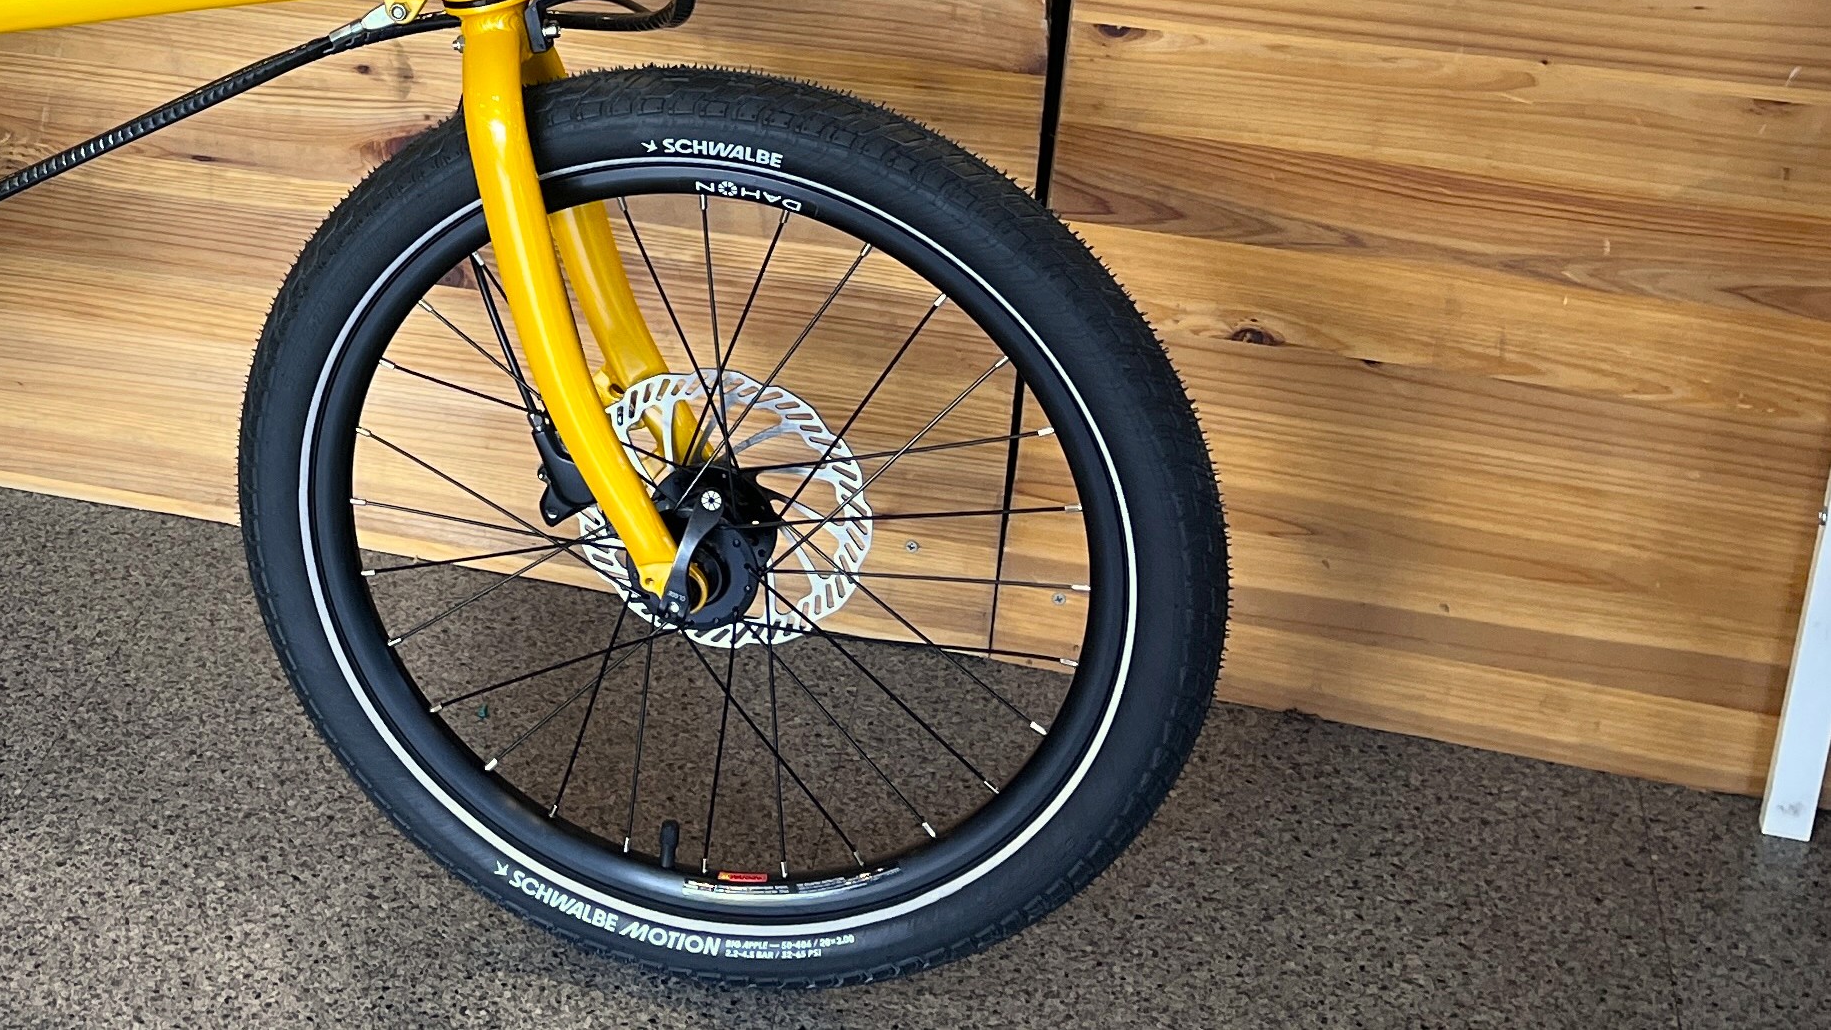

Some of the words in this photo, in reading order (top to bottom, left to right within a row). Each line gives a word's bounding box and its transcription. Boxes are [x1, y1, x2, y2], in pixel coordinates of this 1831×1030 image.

[662, 138, 784, 168] SCHWALBE
[695, 181, 802, 212] DAHON
[508, 870, 619, 932] SCHWALBE
[618, 921, 721, 957] MOTION
